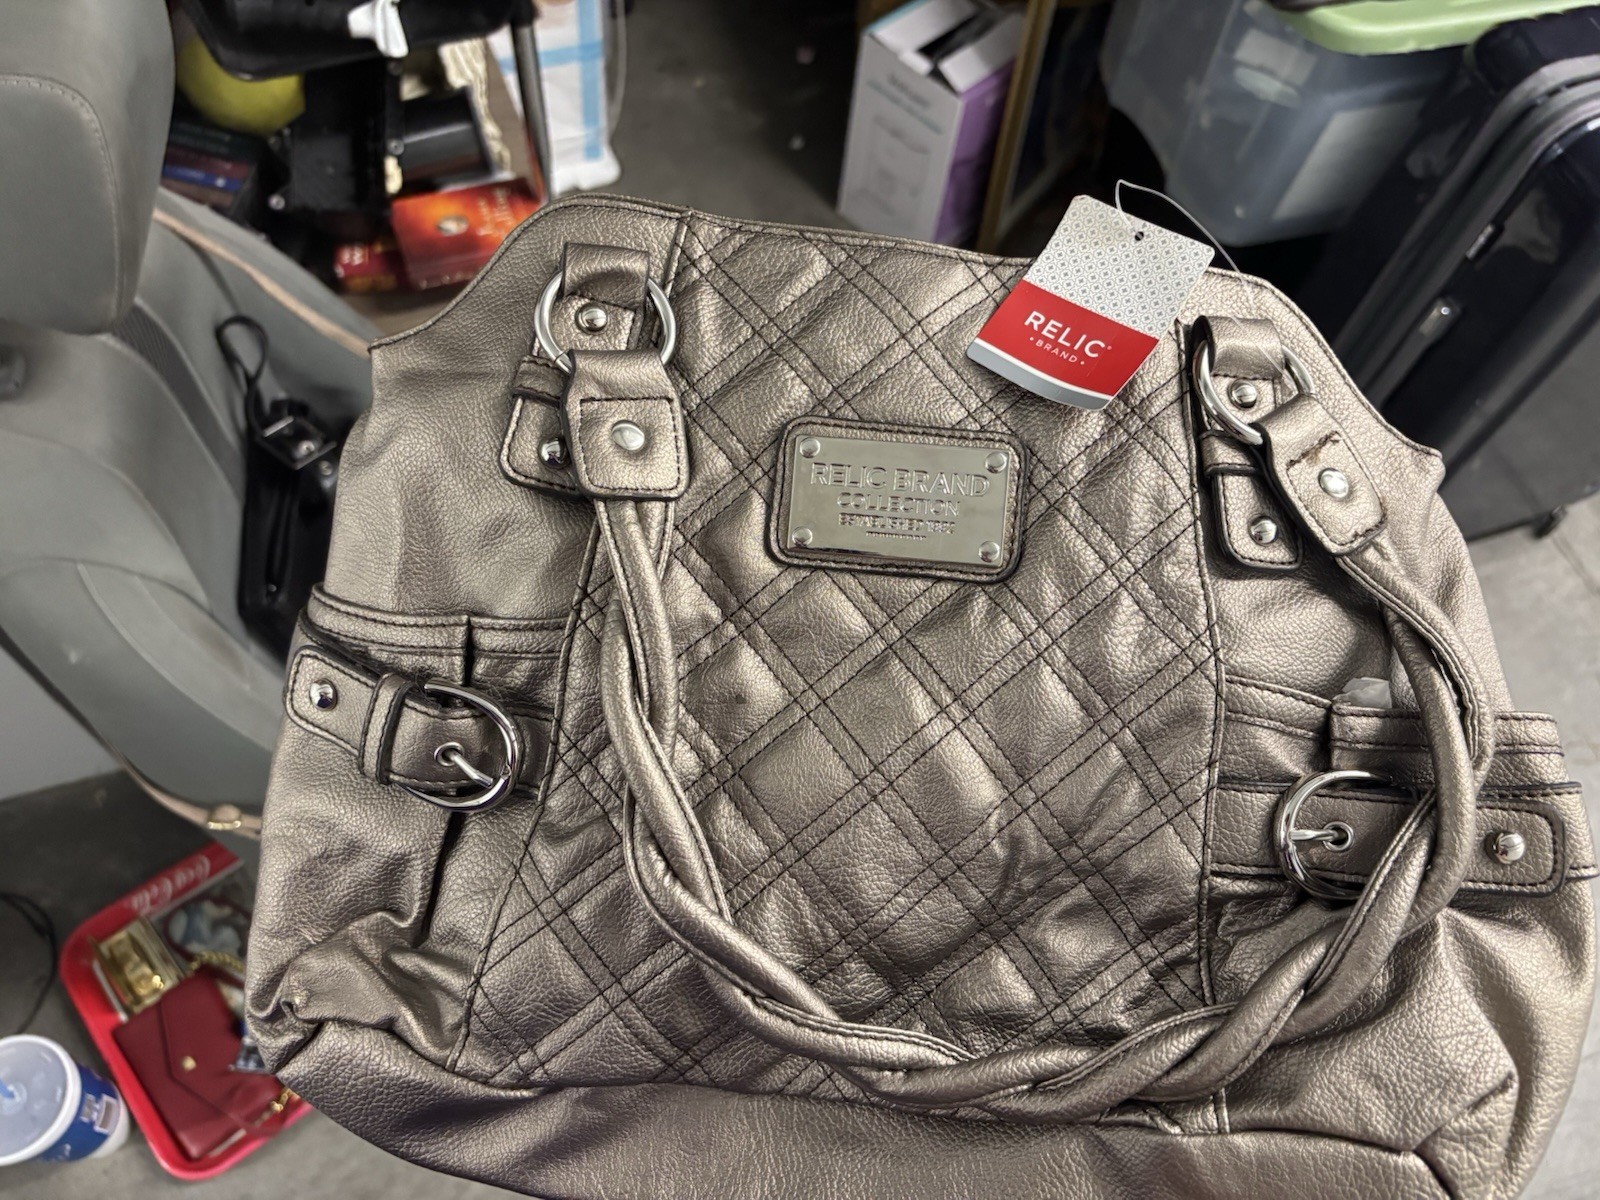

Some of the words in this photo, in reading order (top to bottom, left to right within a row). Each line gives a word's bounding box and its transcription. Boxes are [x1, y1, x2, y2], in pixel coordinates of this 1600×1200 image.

[1024, 310, 1106, 358] RELIC
[1036, 339, 1078, 363] BRAND
[811, 462, 887, 489] RELIC
[893, 468, 990, 497] BRAND
[837, 492, 960, 517] COLLECTION
